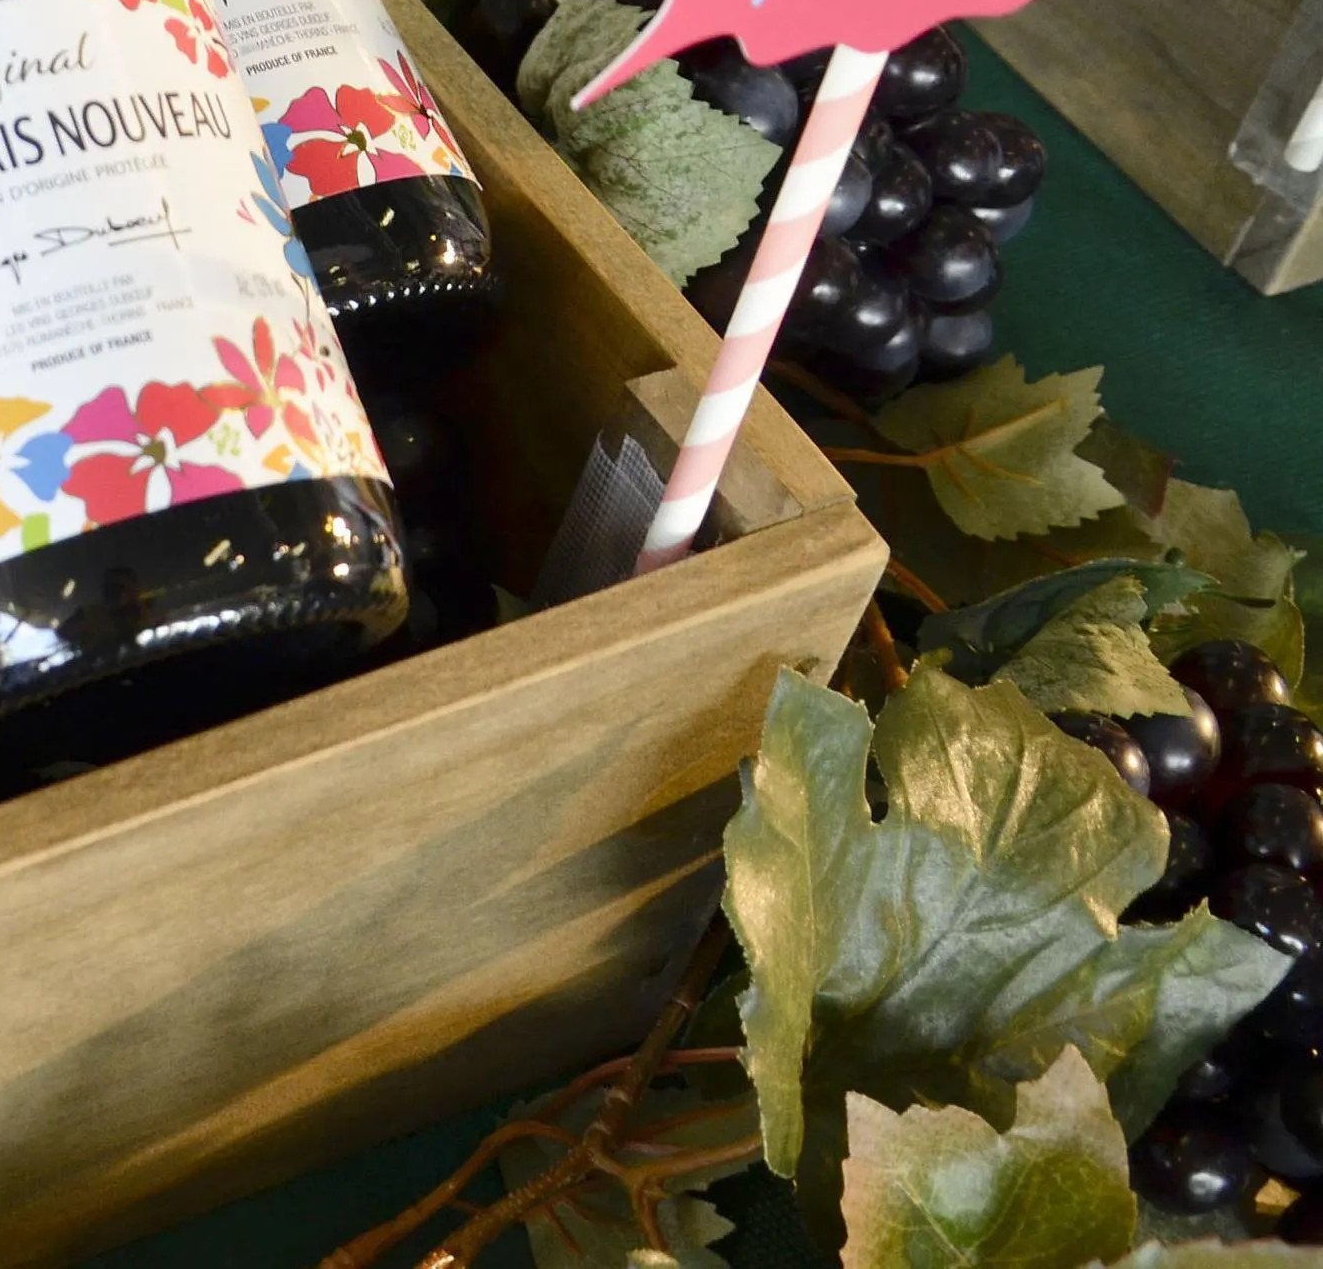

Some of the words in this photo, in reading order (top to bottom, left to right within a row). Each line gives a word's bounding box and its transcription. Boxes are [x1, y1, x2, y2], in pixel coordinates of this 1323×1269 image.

[246, 56, 290, 76] PRODUCE
[292, 51, 303, 63] OF
[305, 45, 337, 60] FRANCE
[47, 92, 232, 156] NOUVEAU
